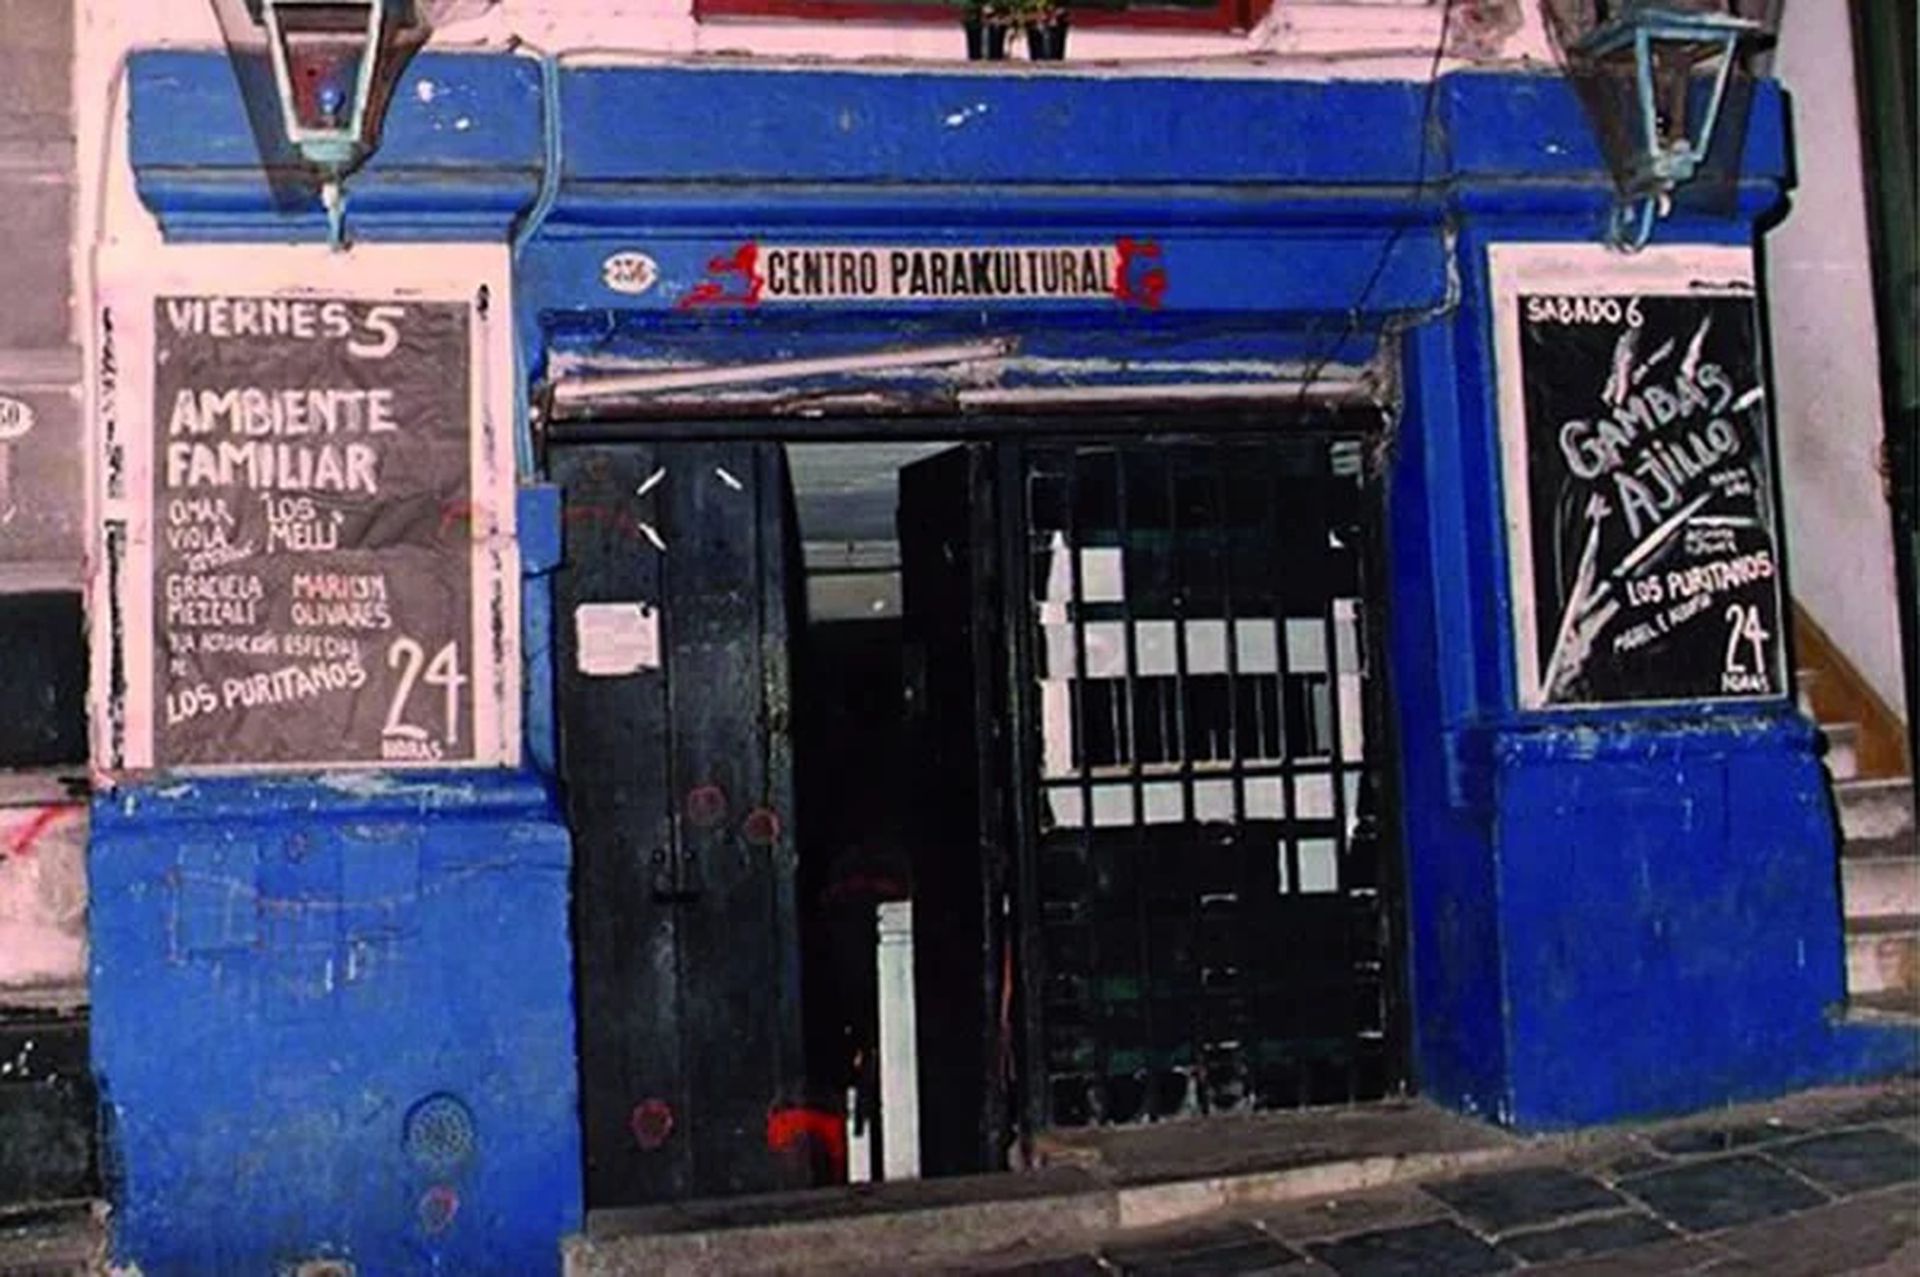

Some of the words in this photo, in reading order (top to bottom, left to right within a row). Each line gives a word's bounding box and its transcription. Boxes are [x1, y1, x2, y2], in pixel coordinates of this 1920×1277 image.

[767, 251, 877, 296] CENTRO
[889, 250, 1115, 296] PARAKULTURAL
[166, 299, 351, 338] VIERNES
[347, 306, 405, 358] 5
[1526, 296, 1622, 324] SABADO
[1625, 297, 1645, 328] 6
[169, 388, 398, 437] AMBIENTE
[1559, 363, 1734, 479] GAMBAS
[166, 440, 379, 494] FAMILIAR
[1626, 574, 1663, 606] LOS
[1667, 551, 1774, 600] PURITANOS
[1724, 602, 1770, 675] 24
[166, 683, 218, 725] LOS
[222, 660, 367, 709] PURITANOS
[381, 636, 468, 744] 24
